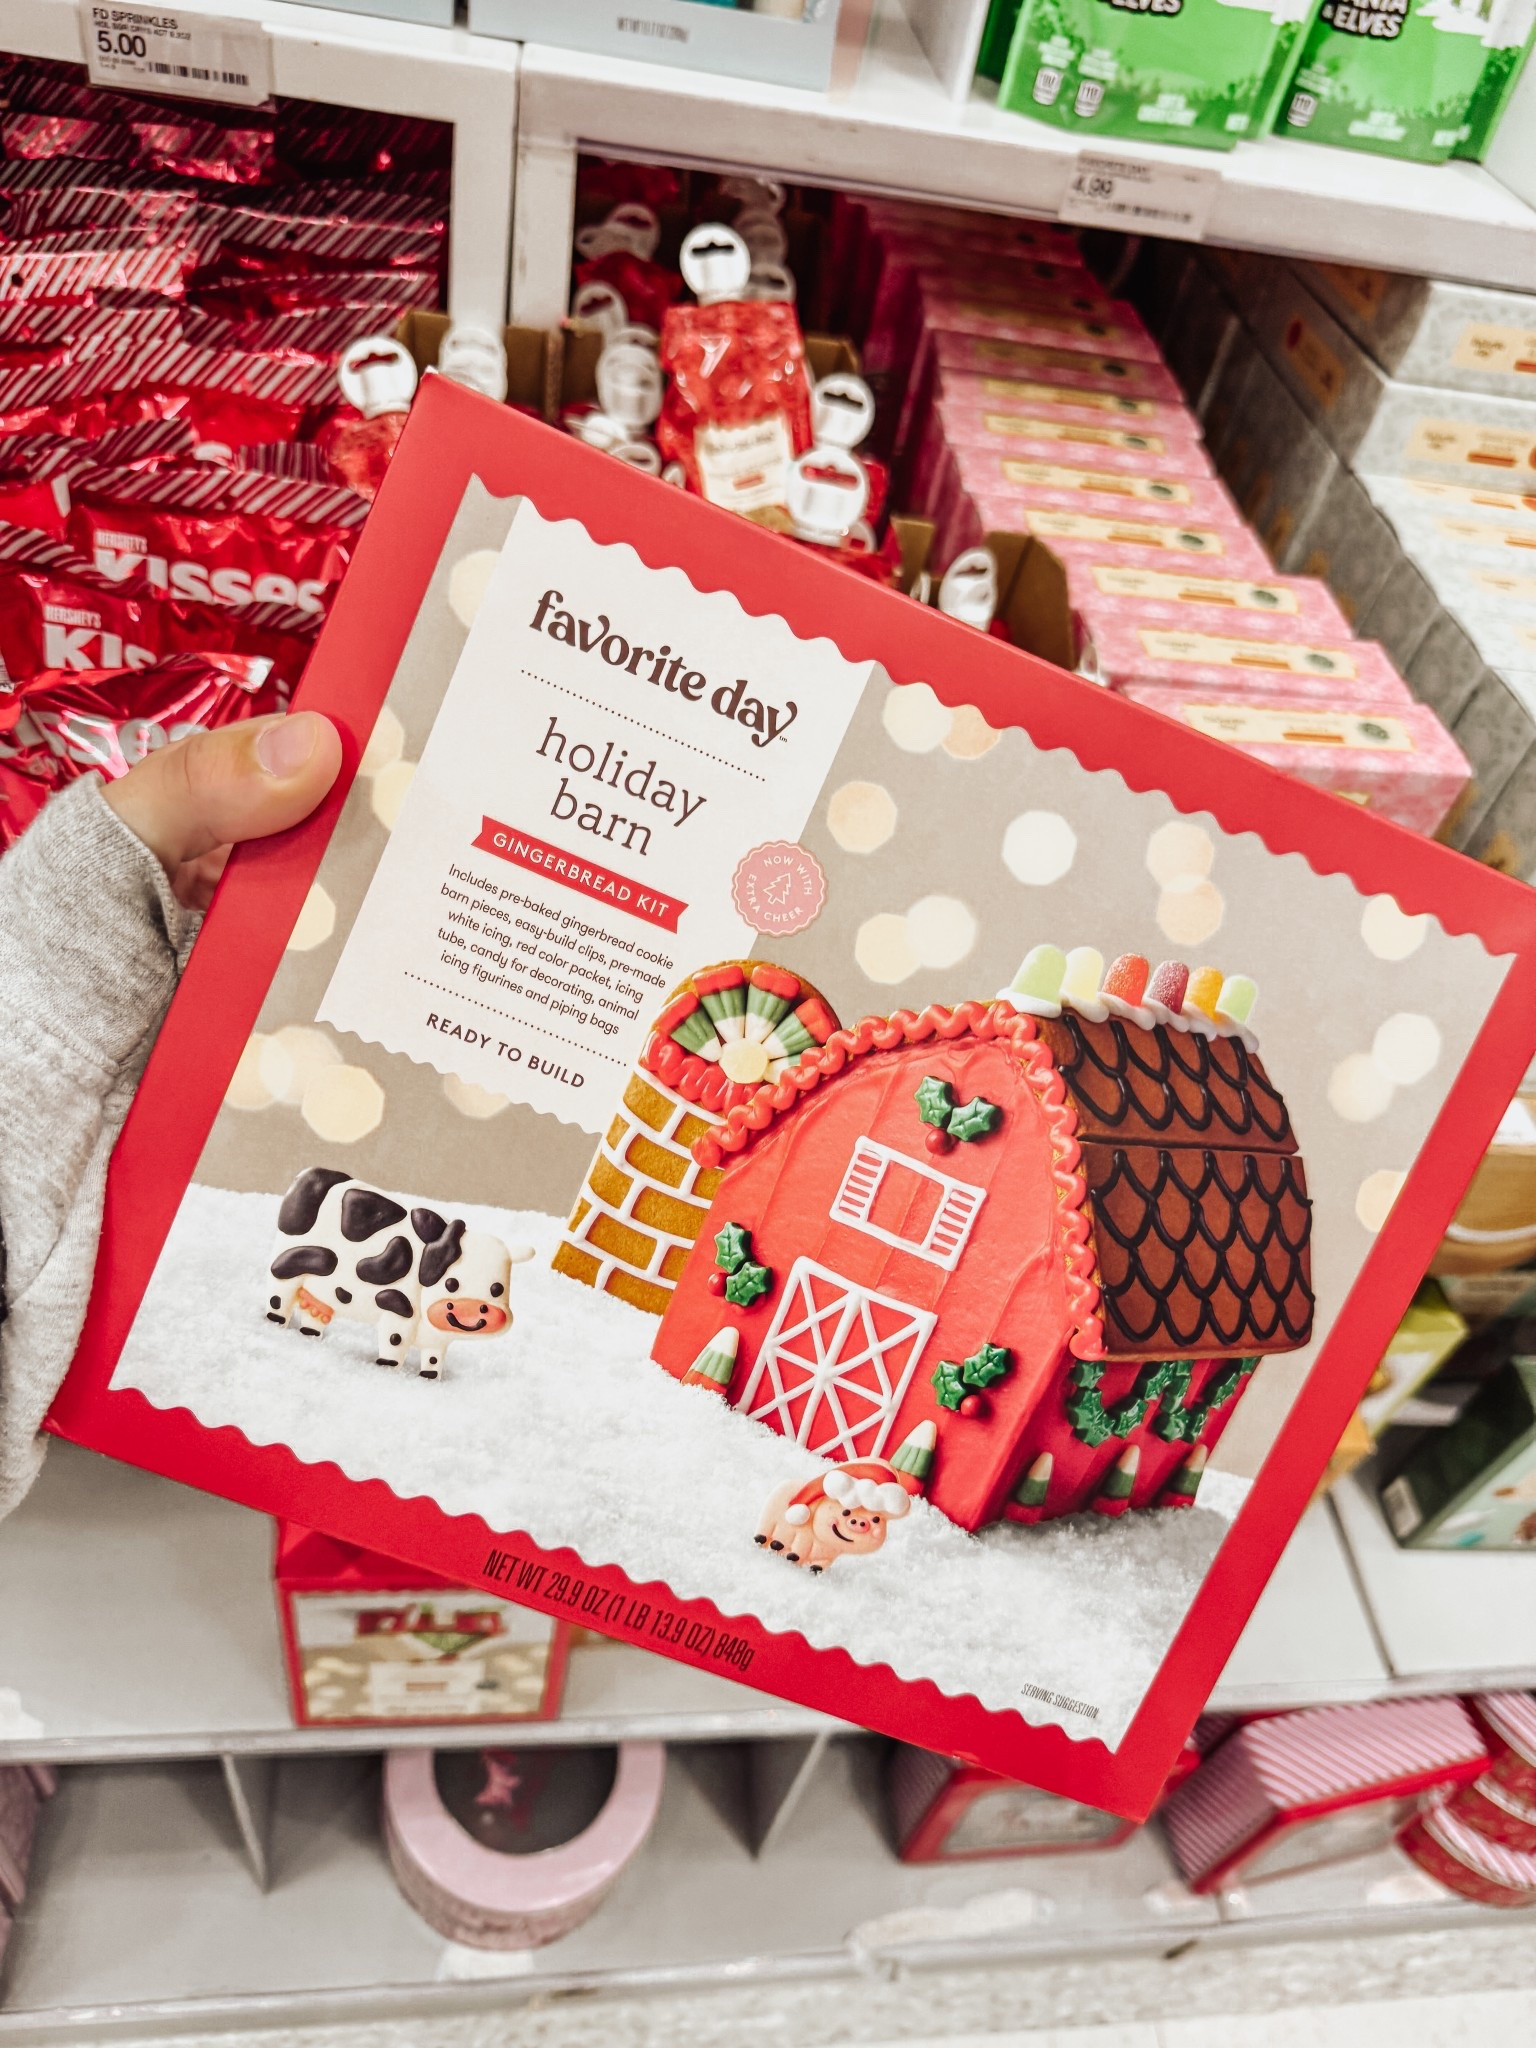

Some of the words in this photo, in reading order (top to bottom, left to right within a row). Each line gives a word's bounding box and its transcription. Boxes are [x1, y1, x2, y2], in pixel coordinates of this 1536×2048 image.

[98, 30, 146, 58] 5.00
[111, 10, 178, 30] SPRINKLES
[1333, 4, 1404, 38] ELVES
[43, 604, 102, 629] HERSHEY'S
[529, 590, 706, 701] favorite
[536, 717, 707, 827] holiday
[551, 778, 651, 856] barn
[494, 833, 630, 900] GINGERBREAD
[637, 894, 669, 916] KIT
[746, 873, 761, 914] EXTRA
[763, 906, 804, 923] CHEER
[763, 855, 793, 867] NOW
[796, 863, 812, 896] WITH
[441, 883, 469, 904] barn
[470, 900, 511, 924] pieces,
[515, 919, 577, 950] easy-build
[578, 945, 606, 965] clips,
[609, 960, 665, 988] pre-made
[449, 864, 498, 894] Includes
[499, 890, 561, 921] pre-baked
[561, 916, 635, 952] gingerbread
[637, 949, 673, 969] cookie
[438, 928, 466, 950] tube,
[471, 944, 508, 968] candy
[511, 958, 528, 973] for
[530, 968, 594, 1004] decorating,
[599, 999, 639, 1020] animal
[441, 950, 469, 974] icing
[473, 964, 523, 993] figurines
[526, 990, 550, 1004] and
[550, 1000, 588, 1024] piping
[590, 1013, 619, 1034] bags
[449, 912, 479, 931] white
[482, 923, 512, 947] icing,
[516, 941, 537, 955] red
[539, 951, 569, 968] color
[569, 964, 611, 989] packet,
[615, 980, 643, 1003] icing
[427, 1013, 491, 1048] READY
[498, 1042, 521, 1061] TO
[528, 1056, 584, 1087] BUILD
[483, 1550, 520, 1582] NET
[516, 1561, 548, 1592] WT
[544, 1572, 584, 1606] 29.9
[581, 1586, 609, 1615] OZ
[605, 1594, 626, 1622] (1
[624, 1600, 651, 1630] LB
[650, 1610, 687, 1643] 13.9
[684, 1623, 715, 1657] OZ)
[713, 1634, 755, 1671] 848g
[1020, 1683, 1055, 1704] SERVING
[1053, 1694, 1100, 1719] SUGGESTION
